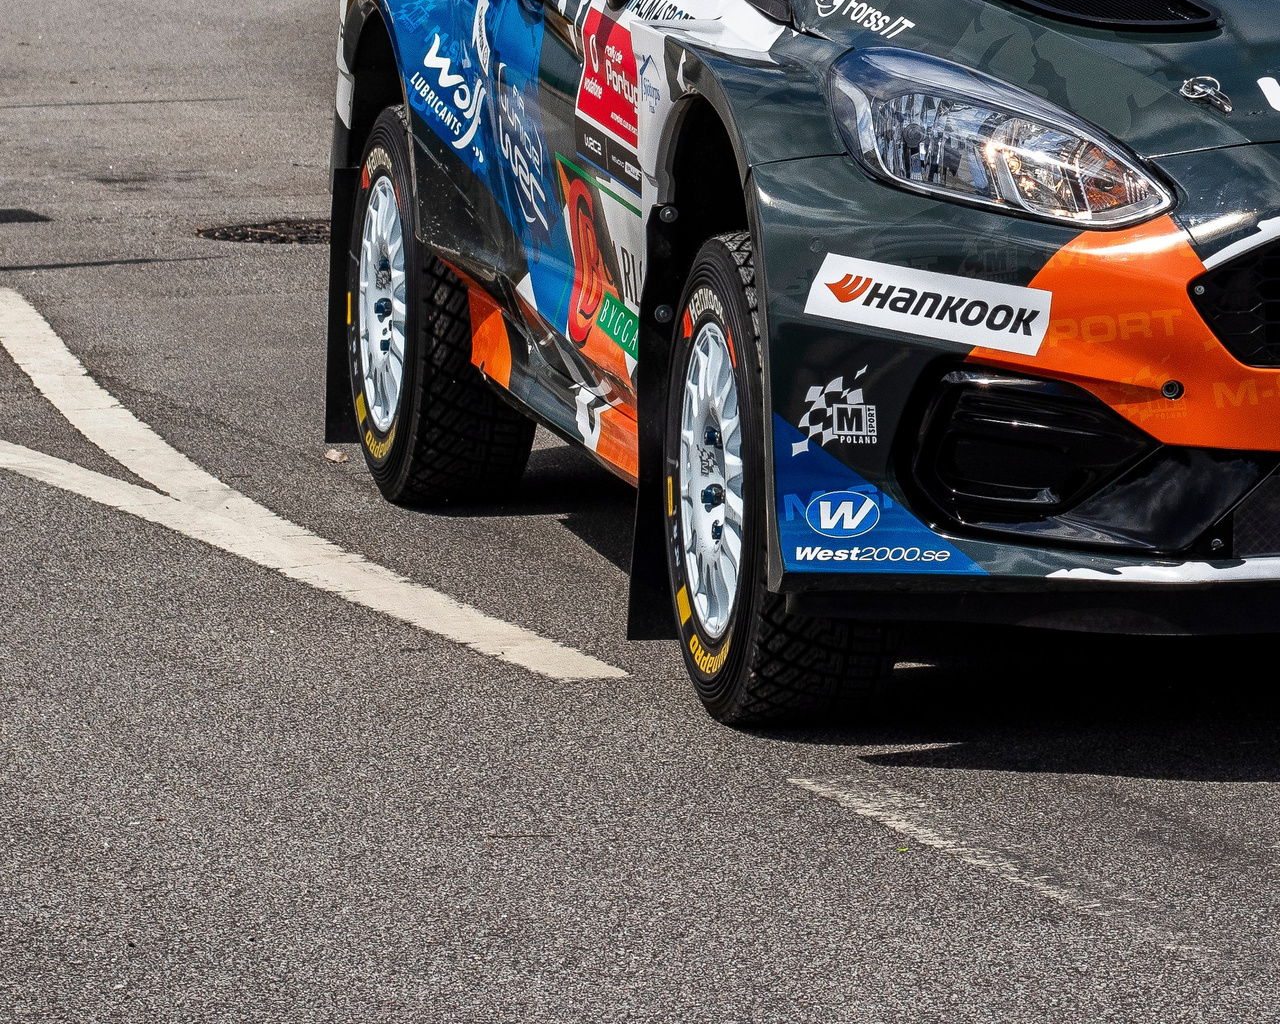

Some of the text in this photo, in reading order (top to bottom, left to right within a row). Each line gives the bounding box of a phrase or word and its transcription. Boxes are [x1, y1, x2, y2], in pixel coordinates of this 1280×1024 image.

[879, 16, 916, 39] IT
[410, 71, 462, 136] LUBRICANTS
[837, 408, 863, 434] M
[867, 405, 878, 437] SPORT
[838, 435, 878, 445] POLAND
[815, 498, 879, 530] W
[795, 545, 951, 563] West2000.se
